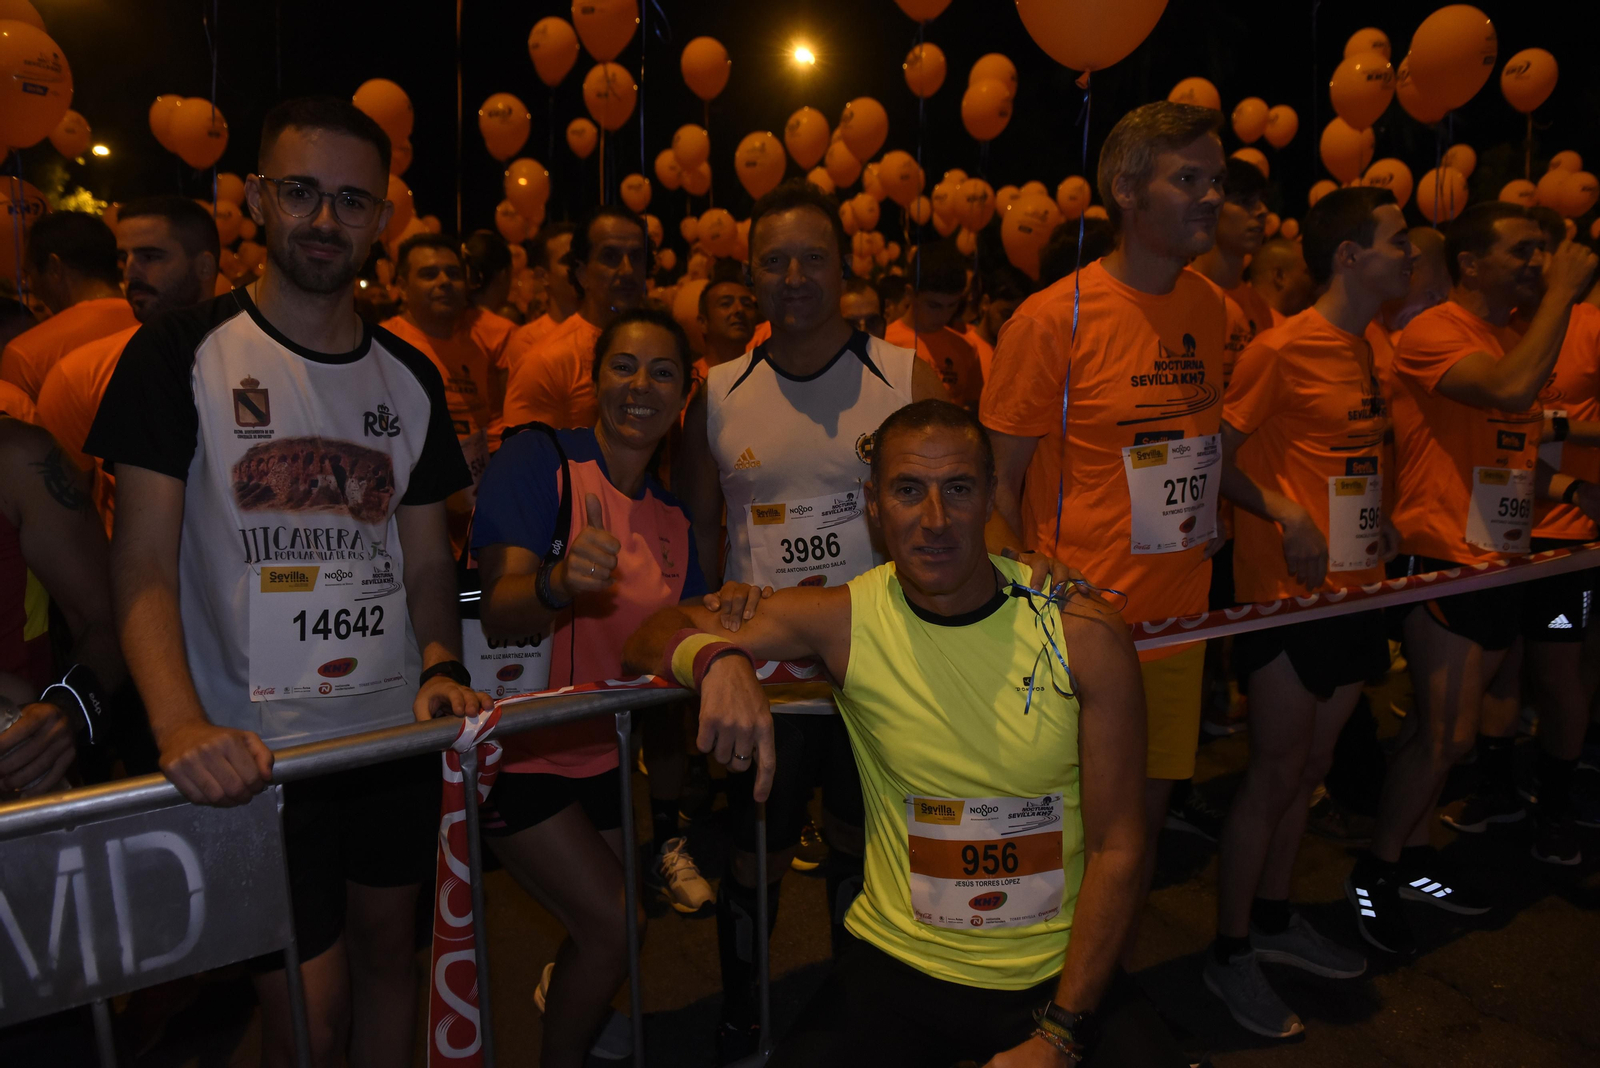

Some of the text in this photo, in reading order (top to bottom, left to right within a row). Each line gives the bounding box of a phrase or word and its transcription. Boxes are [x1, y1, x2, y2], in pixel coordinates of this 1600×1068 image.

[1154, 360, 1205, 371] NOCTURNA
[1130, 373, 1179, 387] SEVILLA
[363, 411, 401, 437] RUS
[734, 460, 761, 471] adidas
[1163, 473, 1208, 506] 2767
[831, 501, 858, 510] NOCTURNA
[821, 508, 844, 517] SEVILLA
[273, 526, 364, 551] CARRERA
[780, 532, 841, 564] 3986
[274, 550, 315, 560] POPULAR
[336, 550, 346, 560] DE
[348, 551, 365, 560] RUS
[786, 565, 809, 573] ANTONIO
[808, 563, 830, 571] GAMERO
[830, 560, 847, 568] SALAS
[293, 605, 385, 641] 14642
[1008, 811, 1036, 819] SEVILLA
[961, 842, 1019, 876] 956
[954, 877, 1021, 887] JESÚS TORRES LÓPEZ
